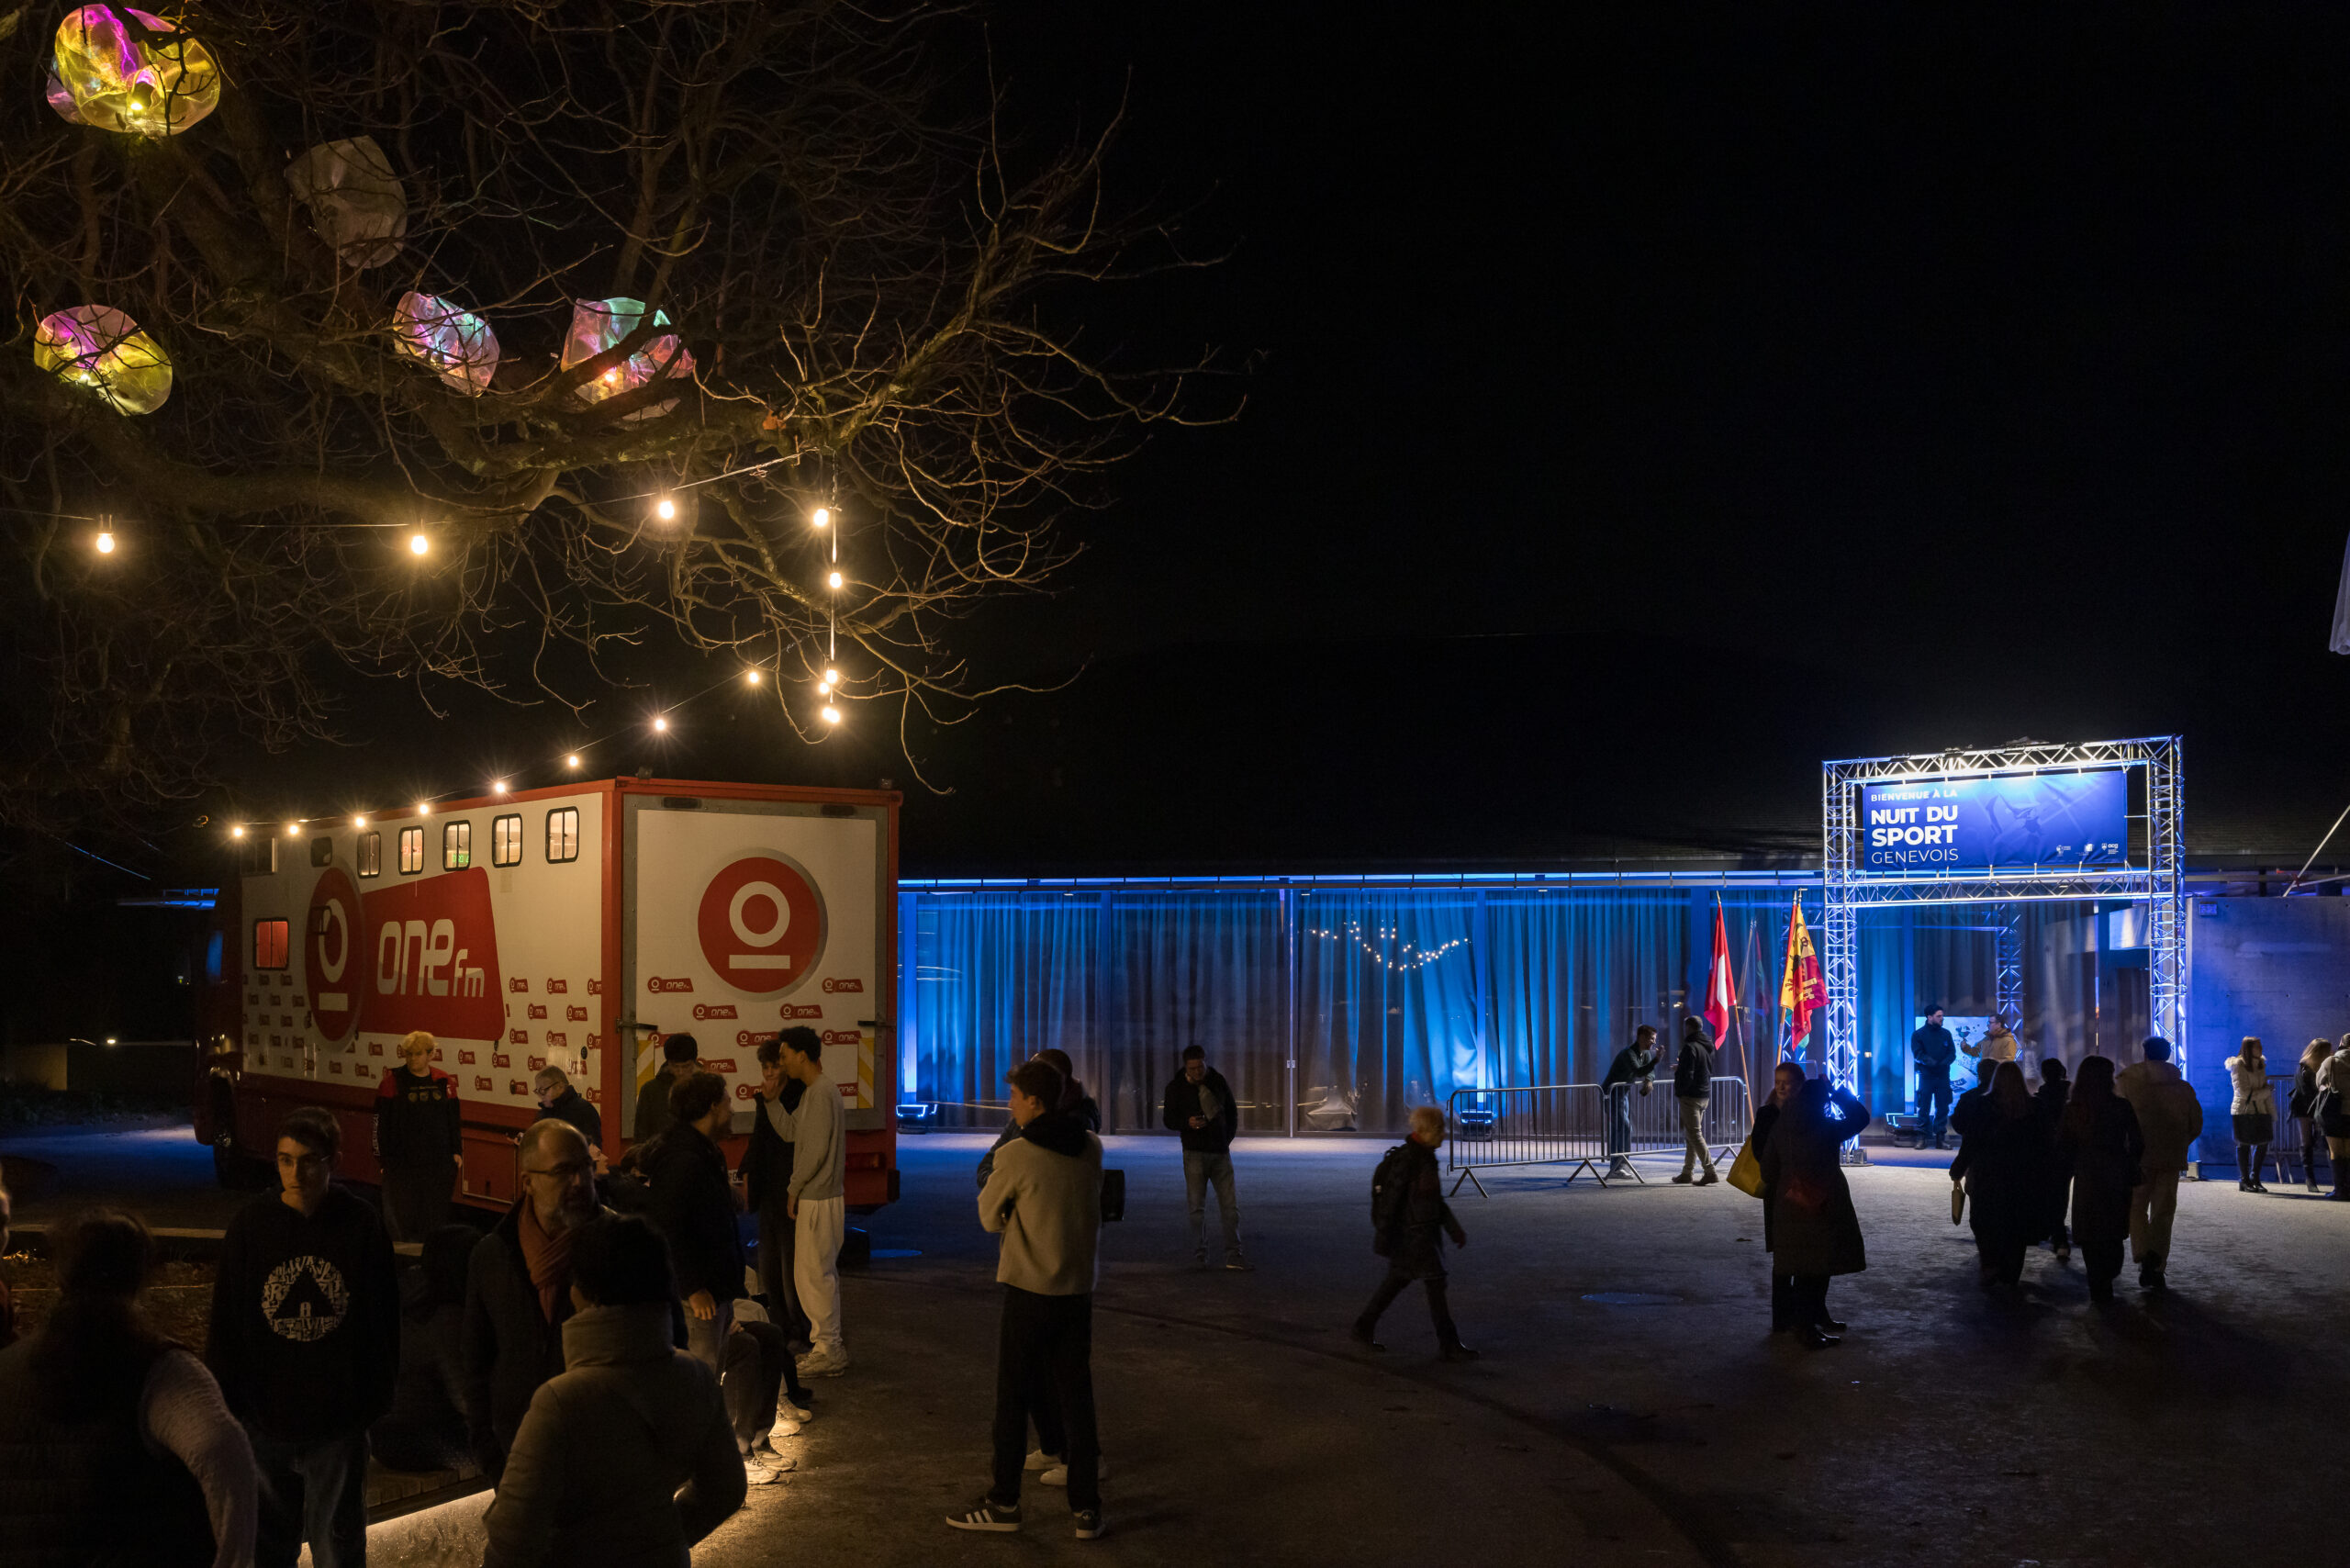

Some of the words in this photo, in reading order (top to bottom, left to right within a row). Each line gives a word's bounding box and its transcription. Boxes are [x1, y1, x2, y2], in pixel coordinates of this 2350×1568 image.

[1871, 790, 1930, 801] BIENVENUE
[1932, 788, 1941, 799] À
[1943, 790, 1958, 798] LA
[1871, 807, 1919, 825] NUIT
[1926, 805, 1958, 823] DU
[1871, 824, 1958, 847] SPORT
[1871, 848, 1959, 864] GENEVOIS
